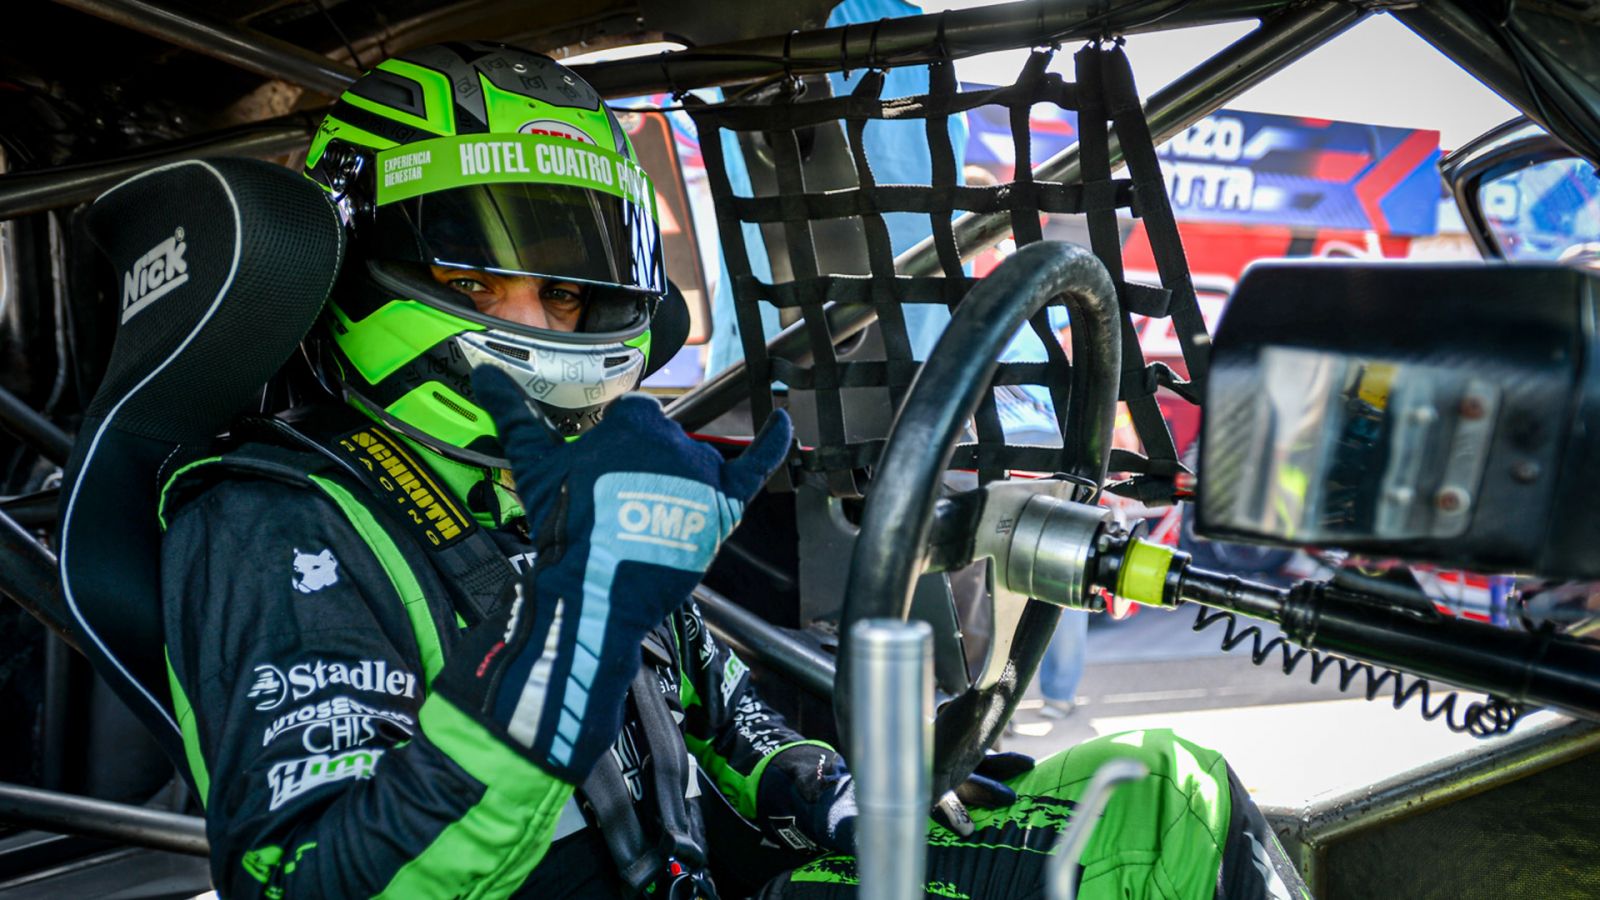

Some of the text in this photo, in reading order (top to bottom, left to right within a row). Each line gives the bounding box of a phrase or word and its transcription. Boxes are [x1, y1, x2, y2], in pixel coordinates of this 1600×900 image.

[384, 150, 431, 173] EXPERIENCIA
[384, 166, 422, 188] BIENESTAR
[459, 142, 530, 176] HOTEL
[536, 143, 613, 187] CUATRO
[617, 501, 706, 542] OMP
[302, 716, 375, 753] CHIS
